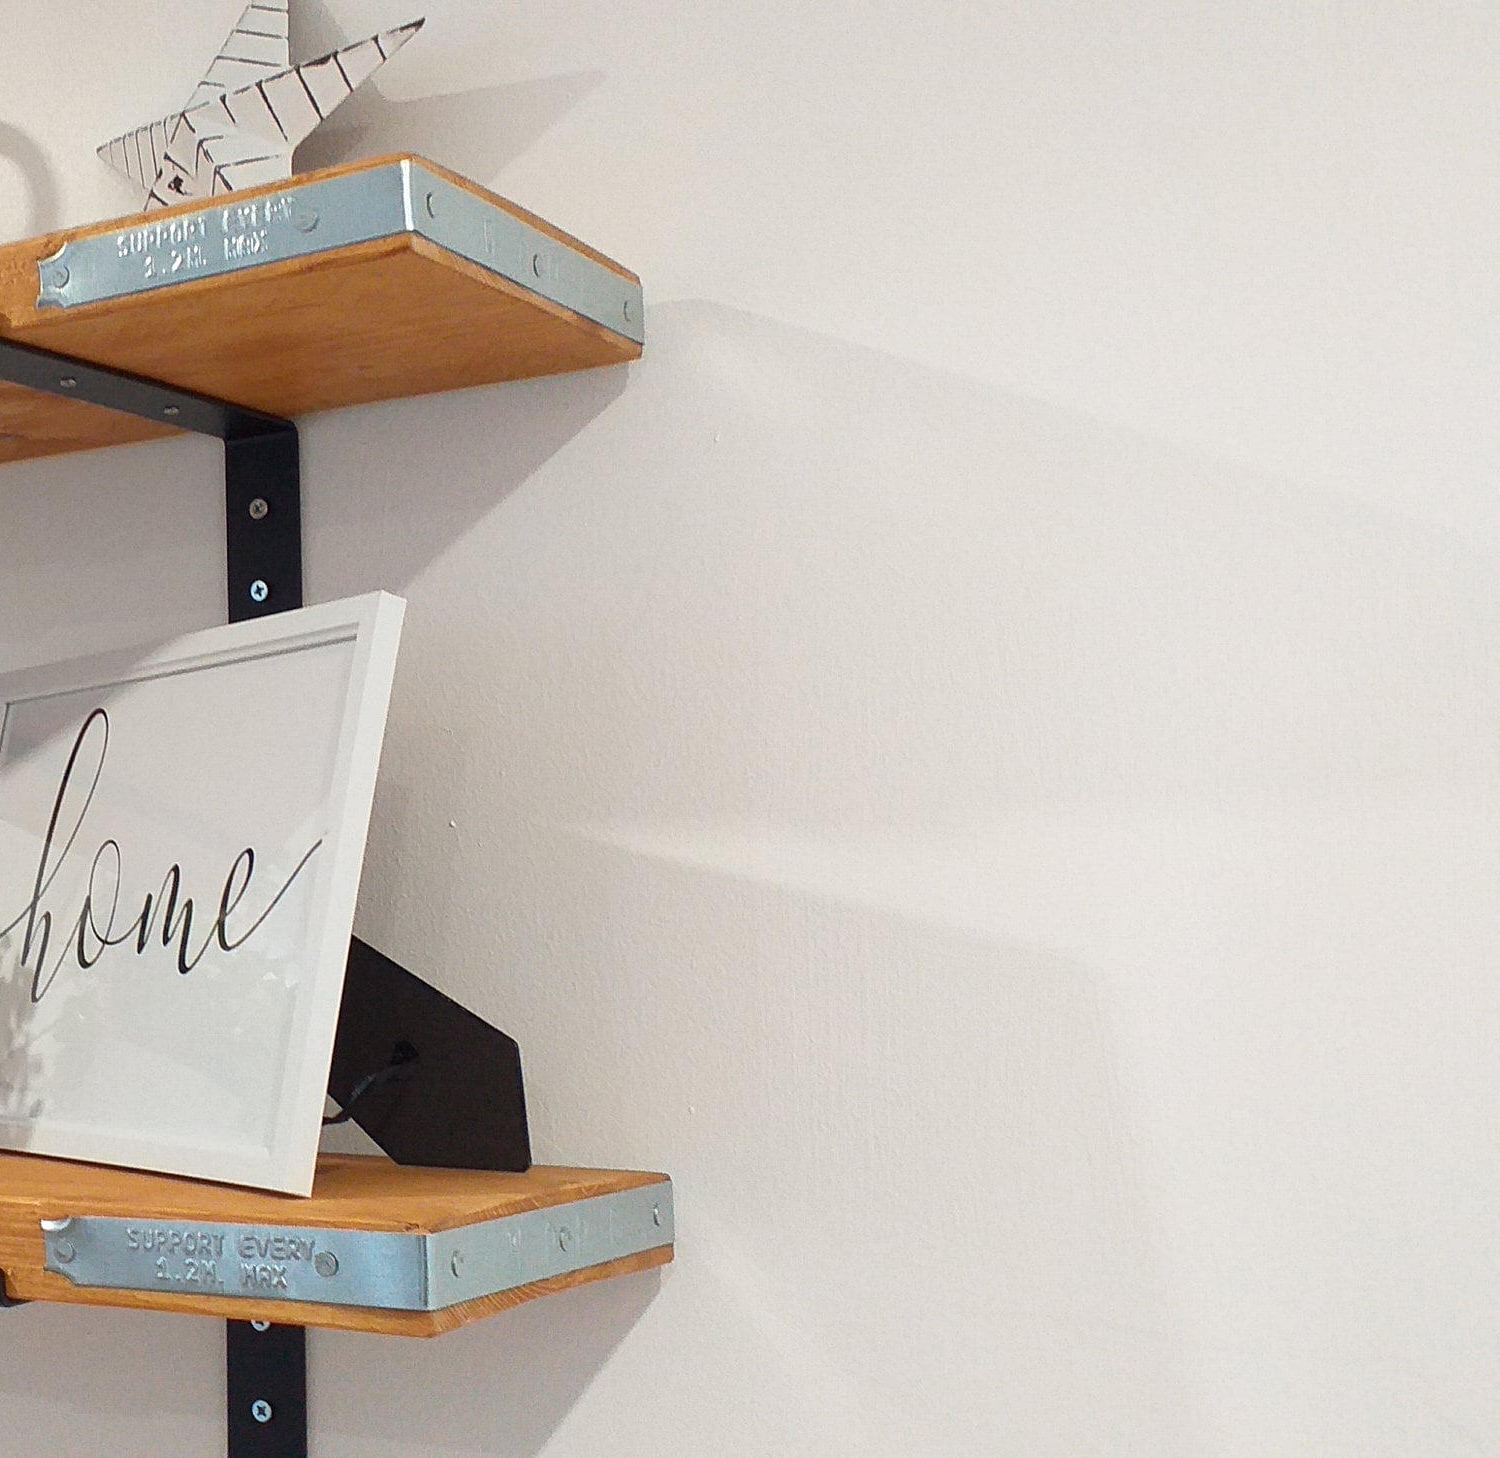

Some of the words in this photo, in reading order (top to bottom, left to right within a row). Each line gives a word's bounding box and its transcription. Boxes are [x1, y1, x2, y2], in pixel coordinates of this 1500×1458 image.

[126, 1227, 225, 1258] SUPPORT
[238, 1235, 317, 1263] EVERY
[240, 1262, 289, 1290] MAX
